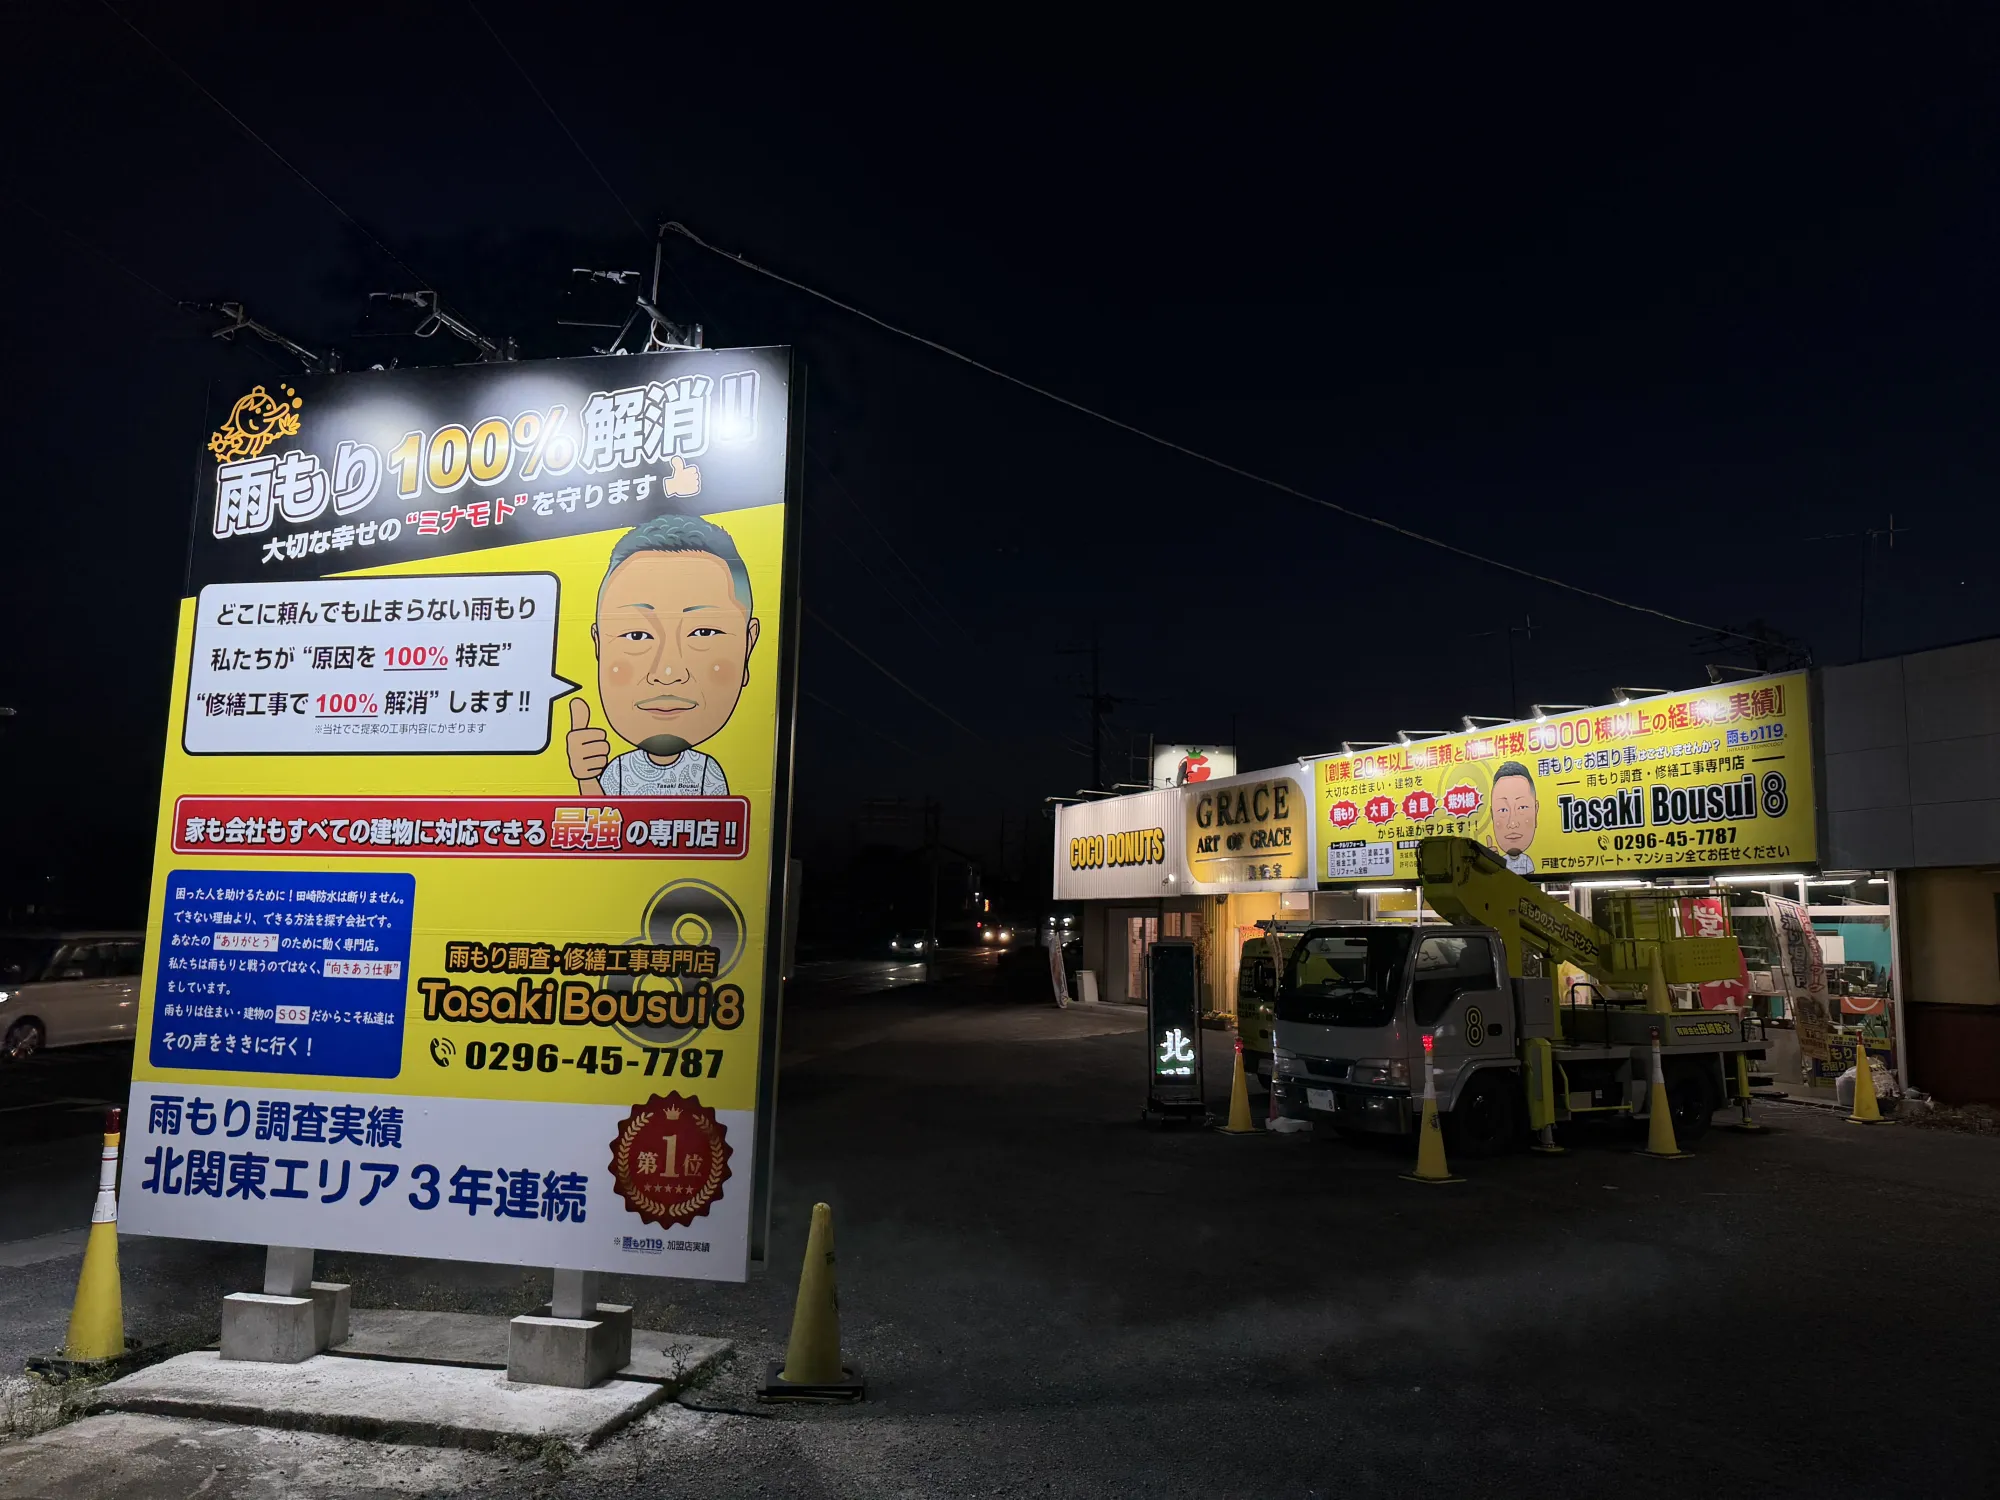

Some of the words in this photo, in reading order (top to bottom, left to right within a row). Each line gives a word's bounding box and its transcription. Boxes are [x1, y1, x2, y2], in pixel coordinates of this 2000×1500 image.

[217, 596, 536, 627] どこに頼んでも止まらない雨もり
[384, 646, 448, 668] 100%
[315, 693, 378, 714] 100%
[314, 722, 486, 735] ※当社でご提案の工事内容にかぎります
[1538, 740, 1720, 776] 雨もりでお困り事はございませんか?
[1587, 756, 1745, 787] 雨もり調査・修繕工事専門店
[1326, 775, 1423, 798] 大切なお住まい・建物を
[1196, 784, 1290, 829] GRACE
[1333, 807, 1354, 822] 雨もり
[1370, 802, 1389, 817] 大雨
[1408, 797, 1429, 813] 台風
[1558, 788, 1644, 832] Tasaki
[1651, 774, 1756, 825] Bousui
[1761, 771, 1788, 817] 8
[184, 816, 547, 848] 家も会社もすべての建物に対応できる
[551, 807, 624, 851] 最強
[1196, 835, 1221, 853] ART
[1250, 827, 1292, 849] GRACE
[1614, 827, 1736, 851] 0296-45-7787
[1070, 835, 1104, 869] COCO
[1107, 827, 1164, 866] DONUTS
[1541, 846, 1790, 869] 戸建てからアパート・マンション全てお任せください
[176, 887, 404, 905] 困った人を助けるために!田崎防水は断りません。
[174, 911, 392, 928] できない理由より、できる方法を探す会社です。
[1519, 898, 1599, 956] 雨もりのスーパードクター
[171, 934, 211, 946] あなたの
[448, 945, 716, 976] 雨もり調査・修繕工事専門店
[168, 981, 231, 995] をしています。
[165, 1003, 274, 1020] 雨もりは住まい・建物の
[279, 1008, 306, 1021] SOS
[311, 1010, 395, 1025] だからこそ私達は
[420, 980, 557, 1025] Tasaki
[567, 983, 707, 1027] Bousui
[710, 985, 743, 1028] 8
[1465, 1006, 1484, 1047] 8
[163, 1032, 312, 1057] その声をききに行く!
[465, 1040, 724, 1079] 0296-45-7787
[148, 1095, 403, 1148] 雨もり調査実績
[637, 1134, 703, 1177] 第1位
[142, 1147, 588, 1224] 北関東エリア3年連続
[667, 1240, 710, 1252] 加盟店実績
